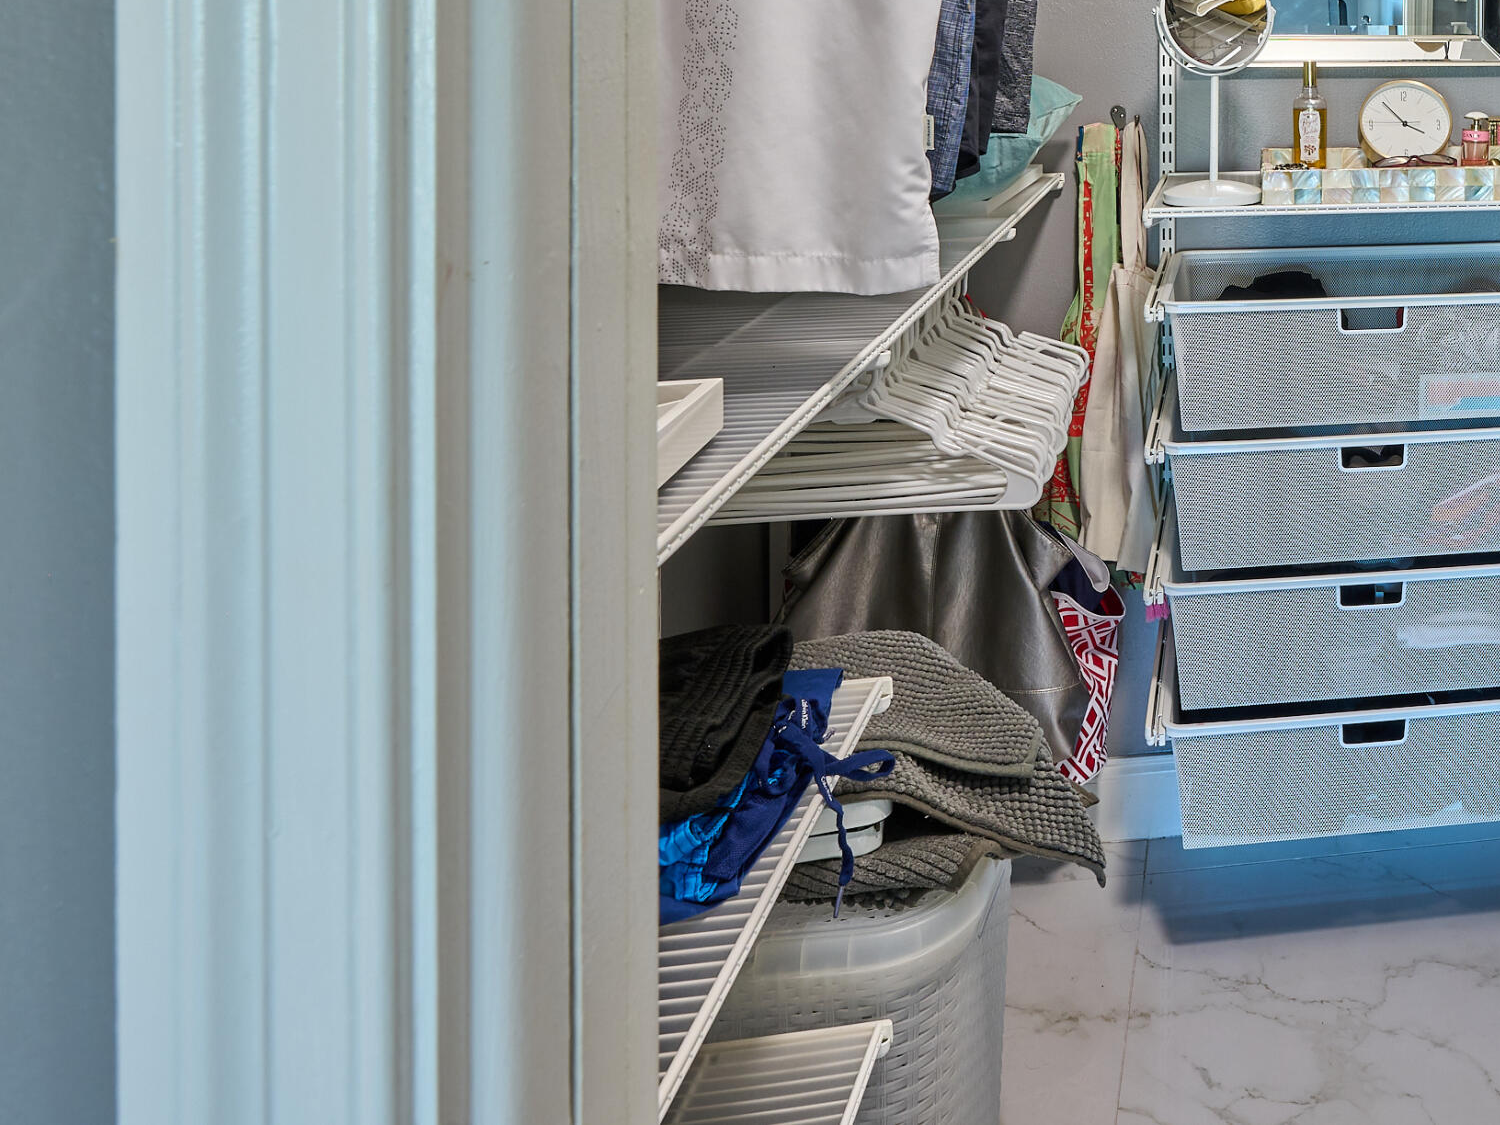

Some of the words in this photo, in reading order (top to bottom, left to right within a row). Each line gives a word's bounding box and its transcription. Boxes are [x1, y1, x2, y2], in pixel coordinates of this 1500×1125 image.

[1401, 91, 1407, 101] 12
[1368, 120, 1374, 130] 9
[1436, 119, 1441, 131] 3
